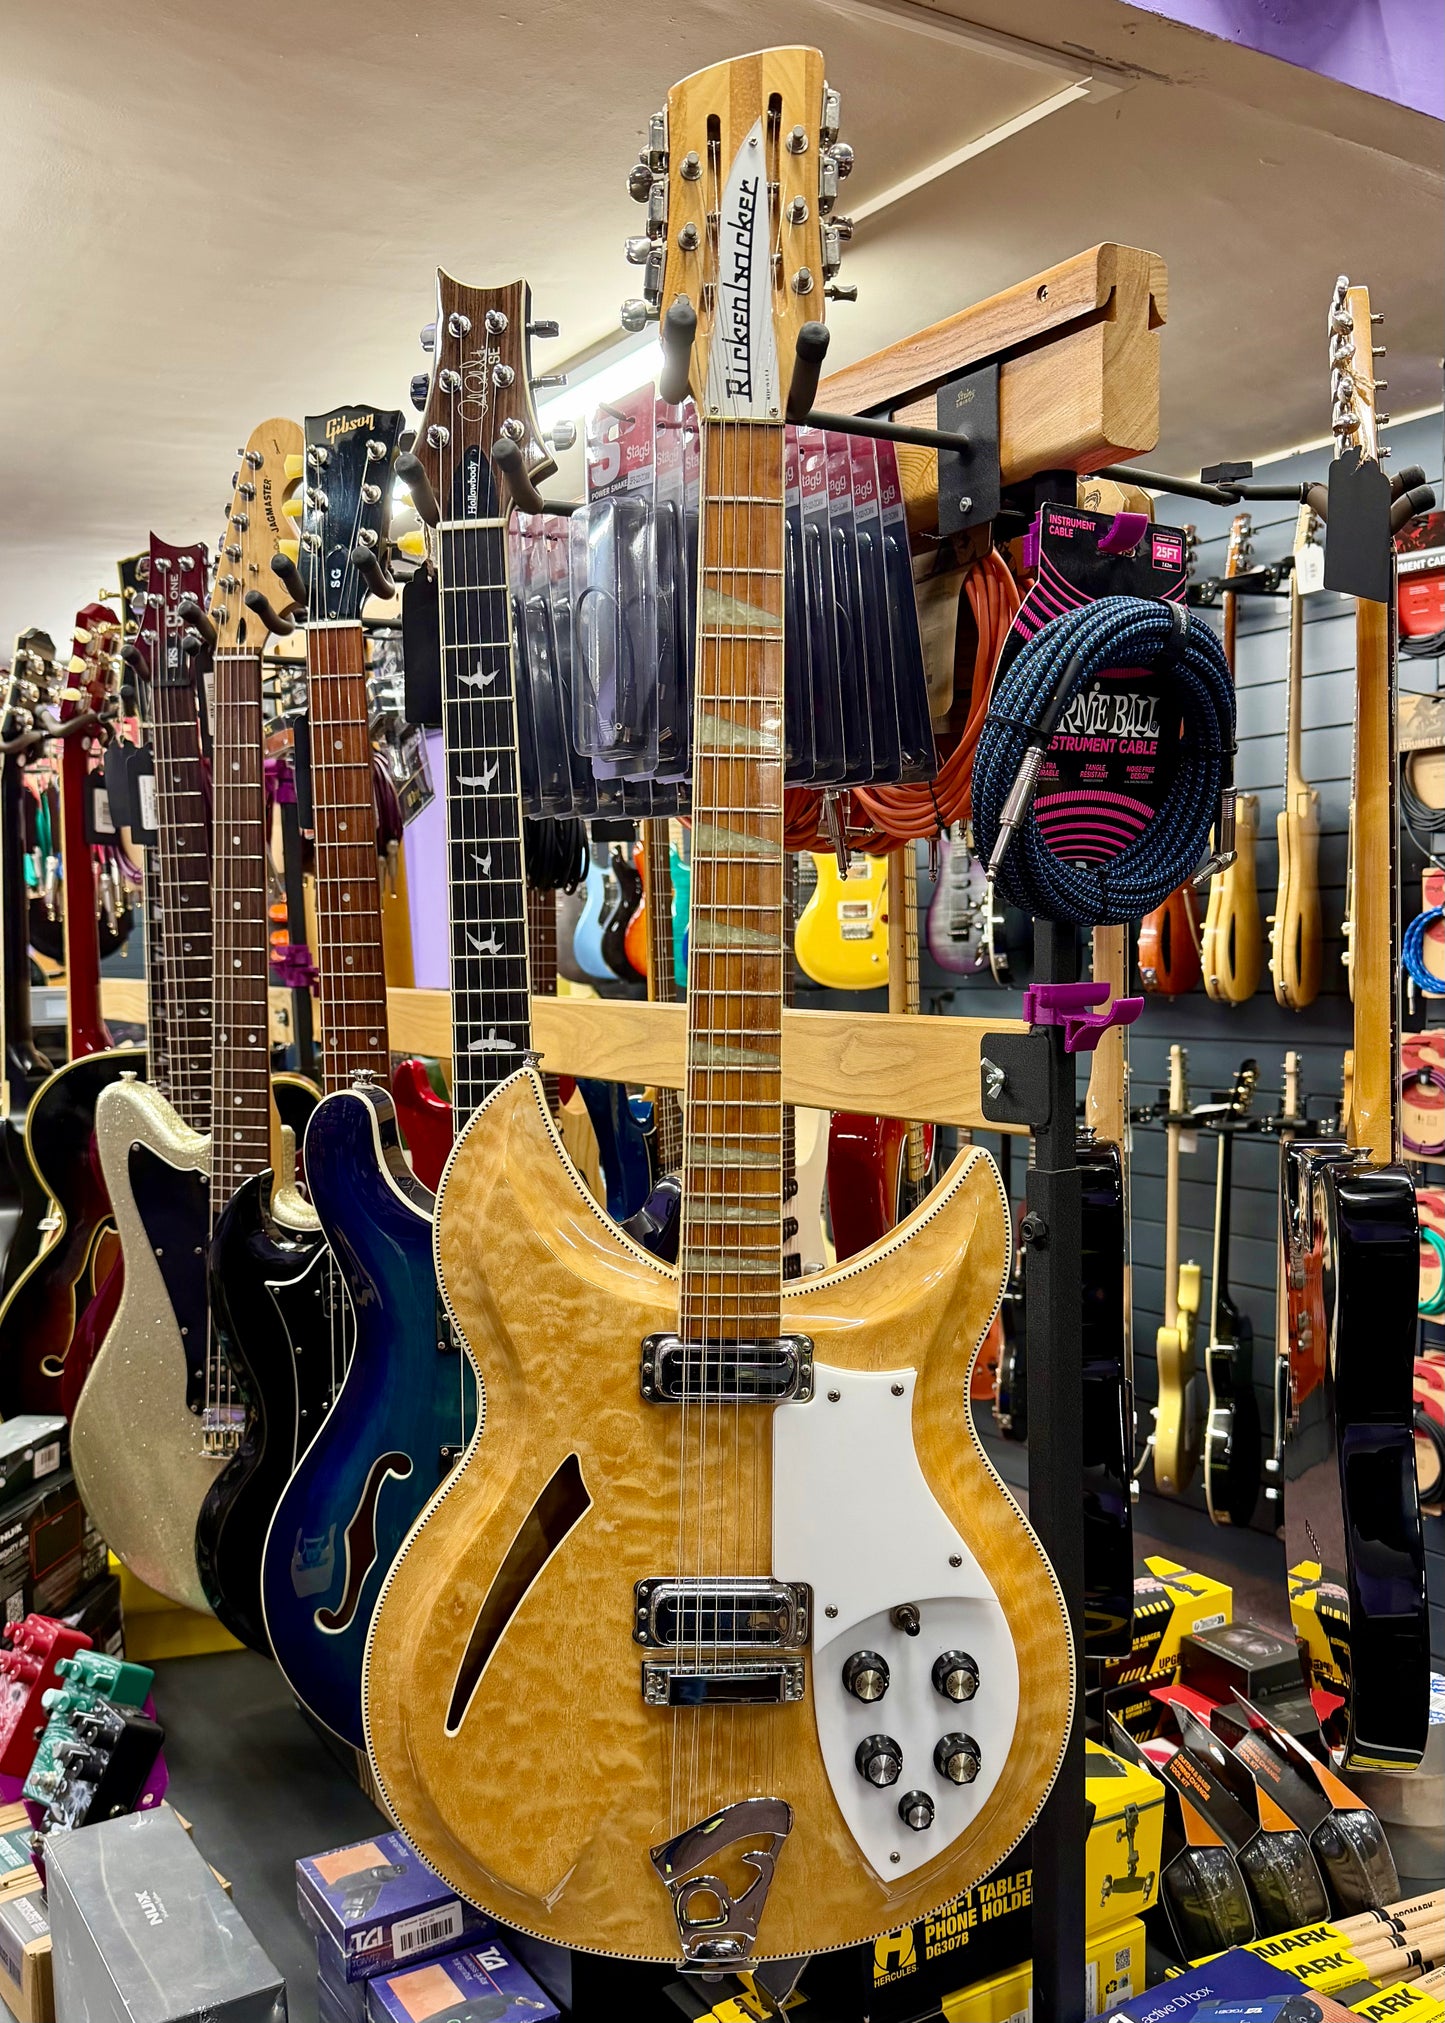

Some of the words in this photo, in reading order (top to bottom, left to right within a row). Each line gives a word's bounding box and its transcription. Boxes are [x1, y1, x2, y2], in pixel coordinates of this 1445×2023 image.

[721, 177, 759, 402] Rickenbacker
[488, 346, 500, 365] SE
[325, 413, 375, 445] Gibson
[626, 440, 650, 462] Stagg
[685, 455, 699, 470] Sta
[467, 460, 480, 515] Hollowbody
[801, 470, 822, 491] tagg
[829, 475, 846, 496] agg
[263, 478, 279, 534] JAGMASTER
[1049, 514, 1097, 532] INSTRUMENT
[1049, 525, 1074, 538] CABLE
[1156, 546, 1179, 560] 25FT
[170, 573, 179, 601] ONE
[330, 568, 342, 588] SG
[168, 647, 178, 668] PRS
[1055, 681, 1111, 735] RNIE
[1107, 693, 1160, 738] BALL
[1047, 735, 1118, 753] STRUMENT
[1119, 739, 1158, 755] CABLE
[1041, 761, 1057, 769] LTRA
[978, 1869, 1033, 1904] TABLET
[134, 1889, 164, 1927] NUX
[925, 1908, 977, 1944] PHONE
[982, 1888, 1033, 1922] HOLDE
[350, 1925, 383, 1953] TGI
[926, 1931, 969, 1960] DG307B
[1252, 1926, 1338, 1959] MARK
[873, 1964, 917, 1989] HERCULES
[1141, 2003, 1177, 2023] active
[1172, 1992, 1192, 2008] DI
[1187, 1986, 1215, 2006] box
